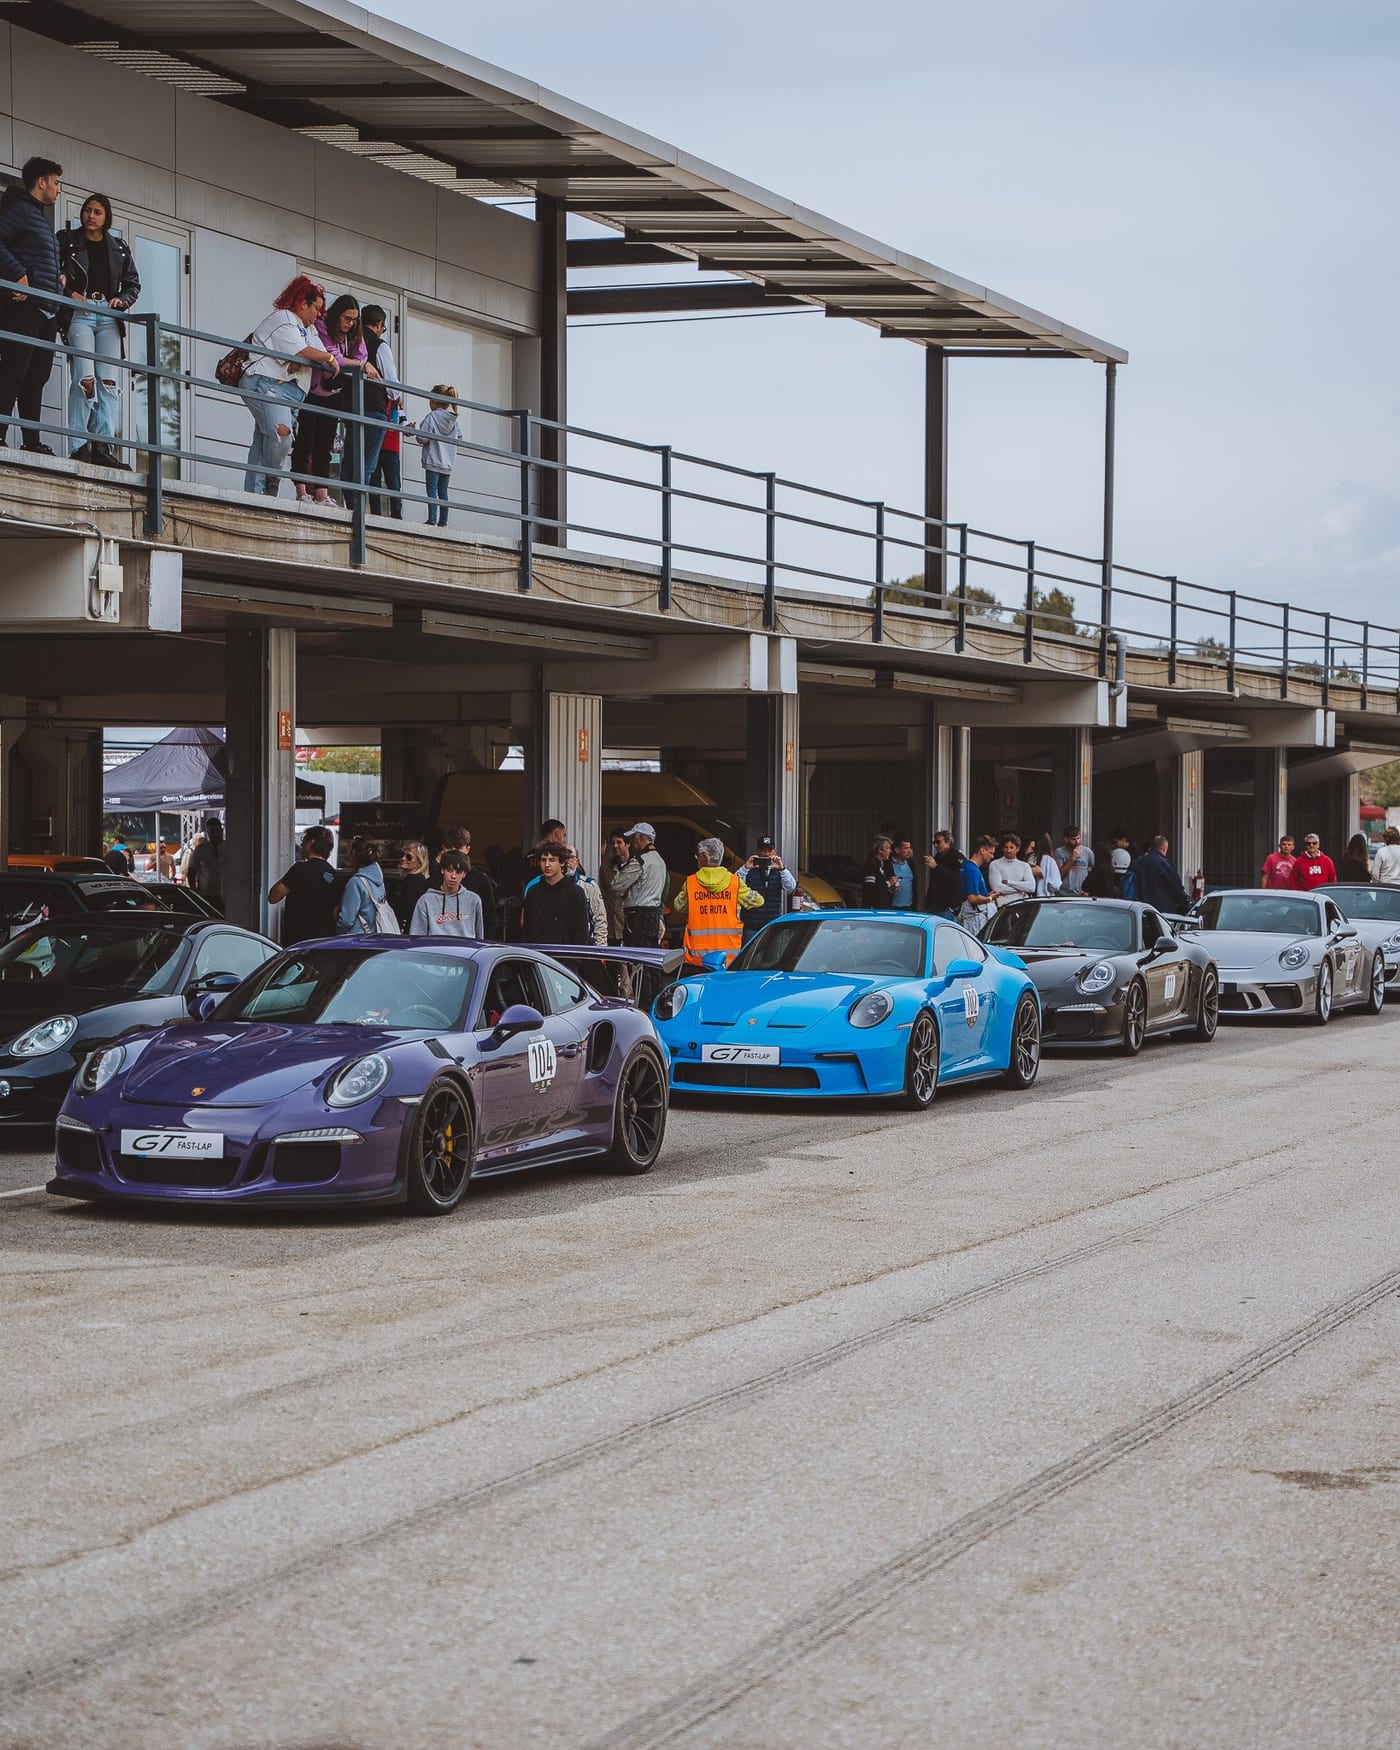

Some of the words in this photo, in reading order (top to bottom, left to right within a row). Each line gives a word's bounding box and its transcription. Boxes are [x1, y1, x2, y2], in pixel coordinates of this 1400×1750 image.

[694, 891, 732, 901] COMISSARI
[699, 905, 708, 915] DE
[709, 905, 728, 915] RUTA
[532, 1042, 554, 1079] 104
[710, 1048, 751, 1061] GT
[743, 1052, 770, 1060] FAST-LAP
[132, 1134, 187, 1153] GT
[176, 1141, 213, 1151] FAST-LAP
